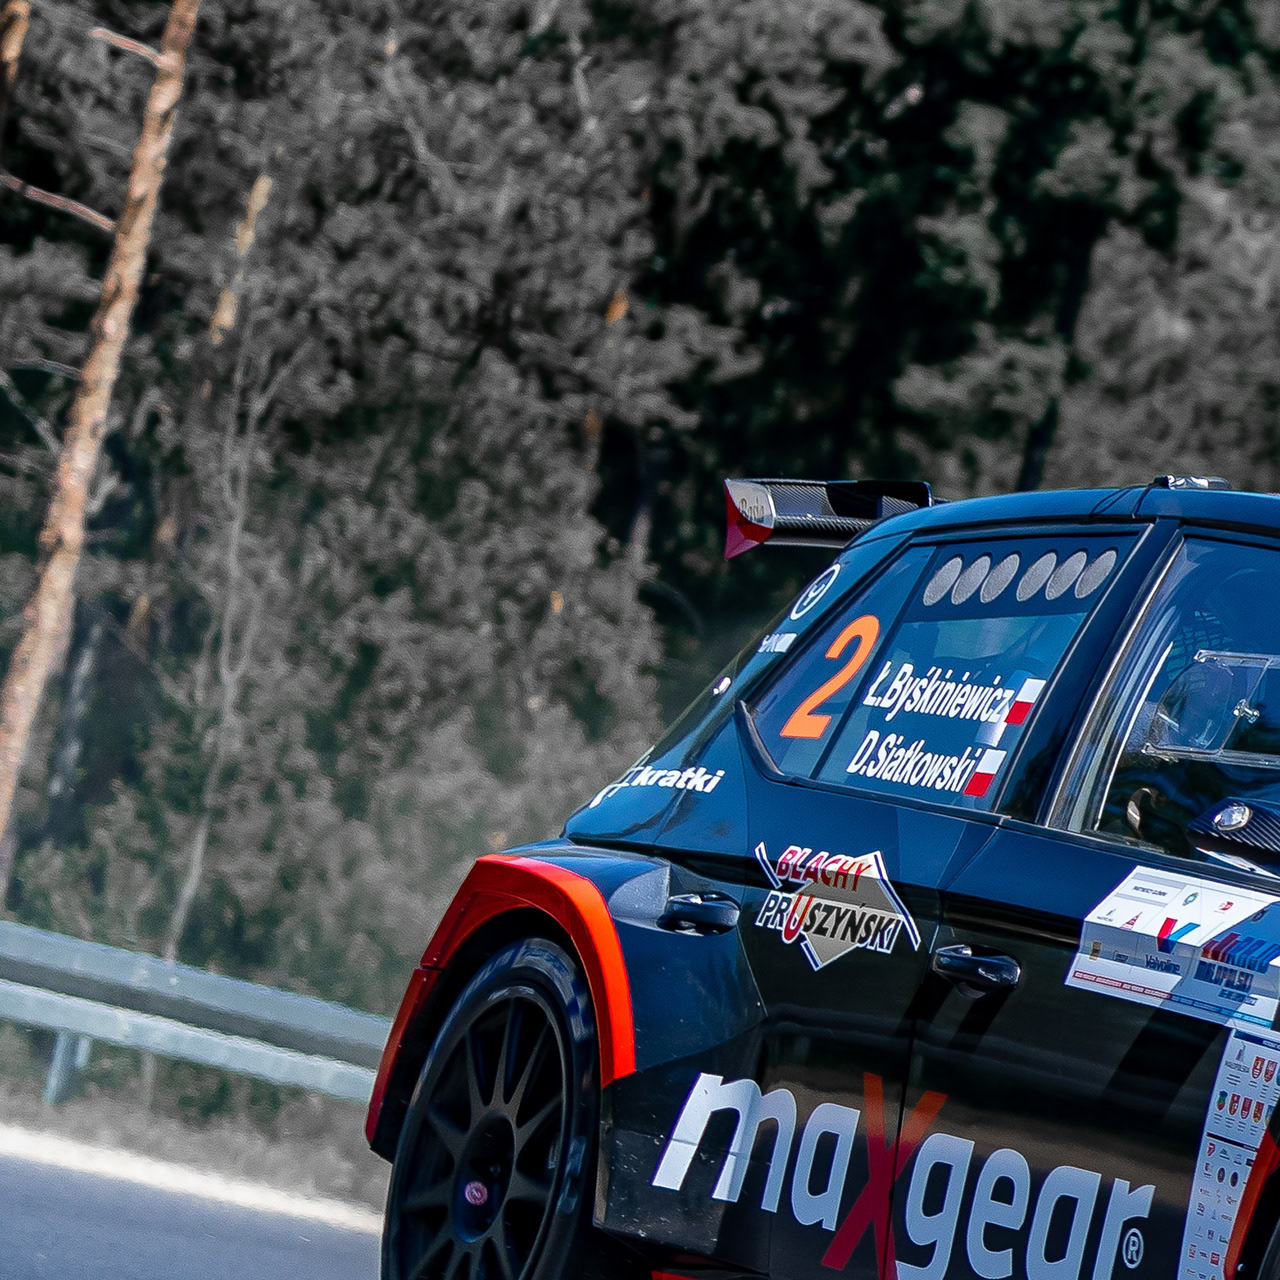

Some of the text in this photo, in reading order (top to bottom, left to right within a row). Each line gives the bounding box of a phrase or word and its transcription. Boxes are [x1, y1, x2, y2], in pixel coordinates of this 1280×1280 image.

[780, 614, 880, 739] 2
[630, 766, 726, 794] kratki
[845, 729, 979, 794] D.Siatkowski
[774, 845, 874, 893] BLACHY
[754, 888, 904, 954] PRUSZYŃSKI
[1145, 954, 1181, 974] Valvoline
